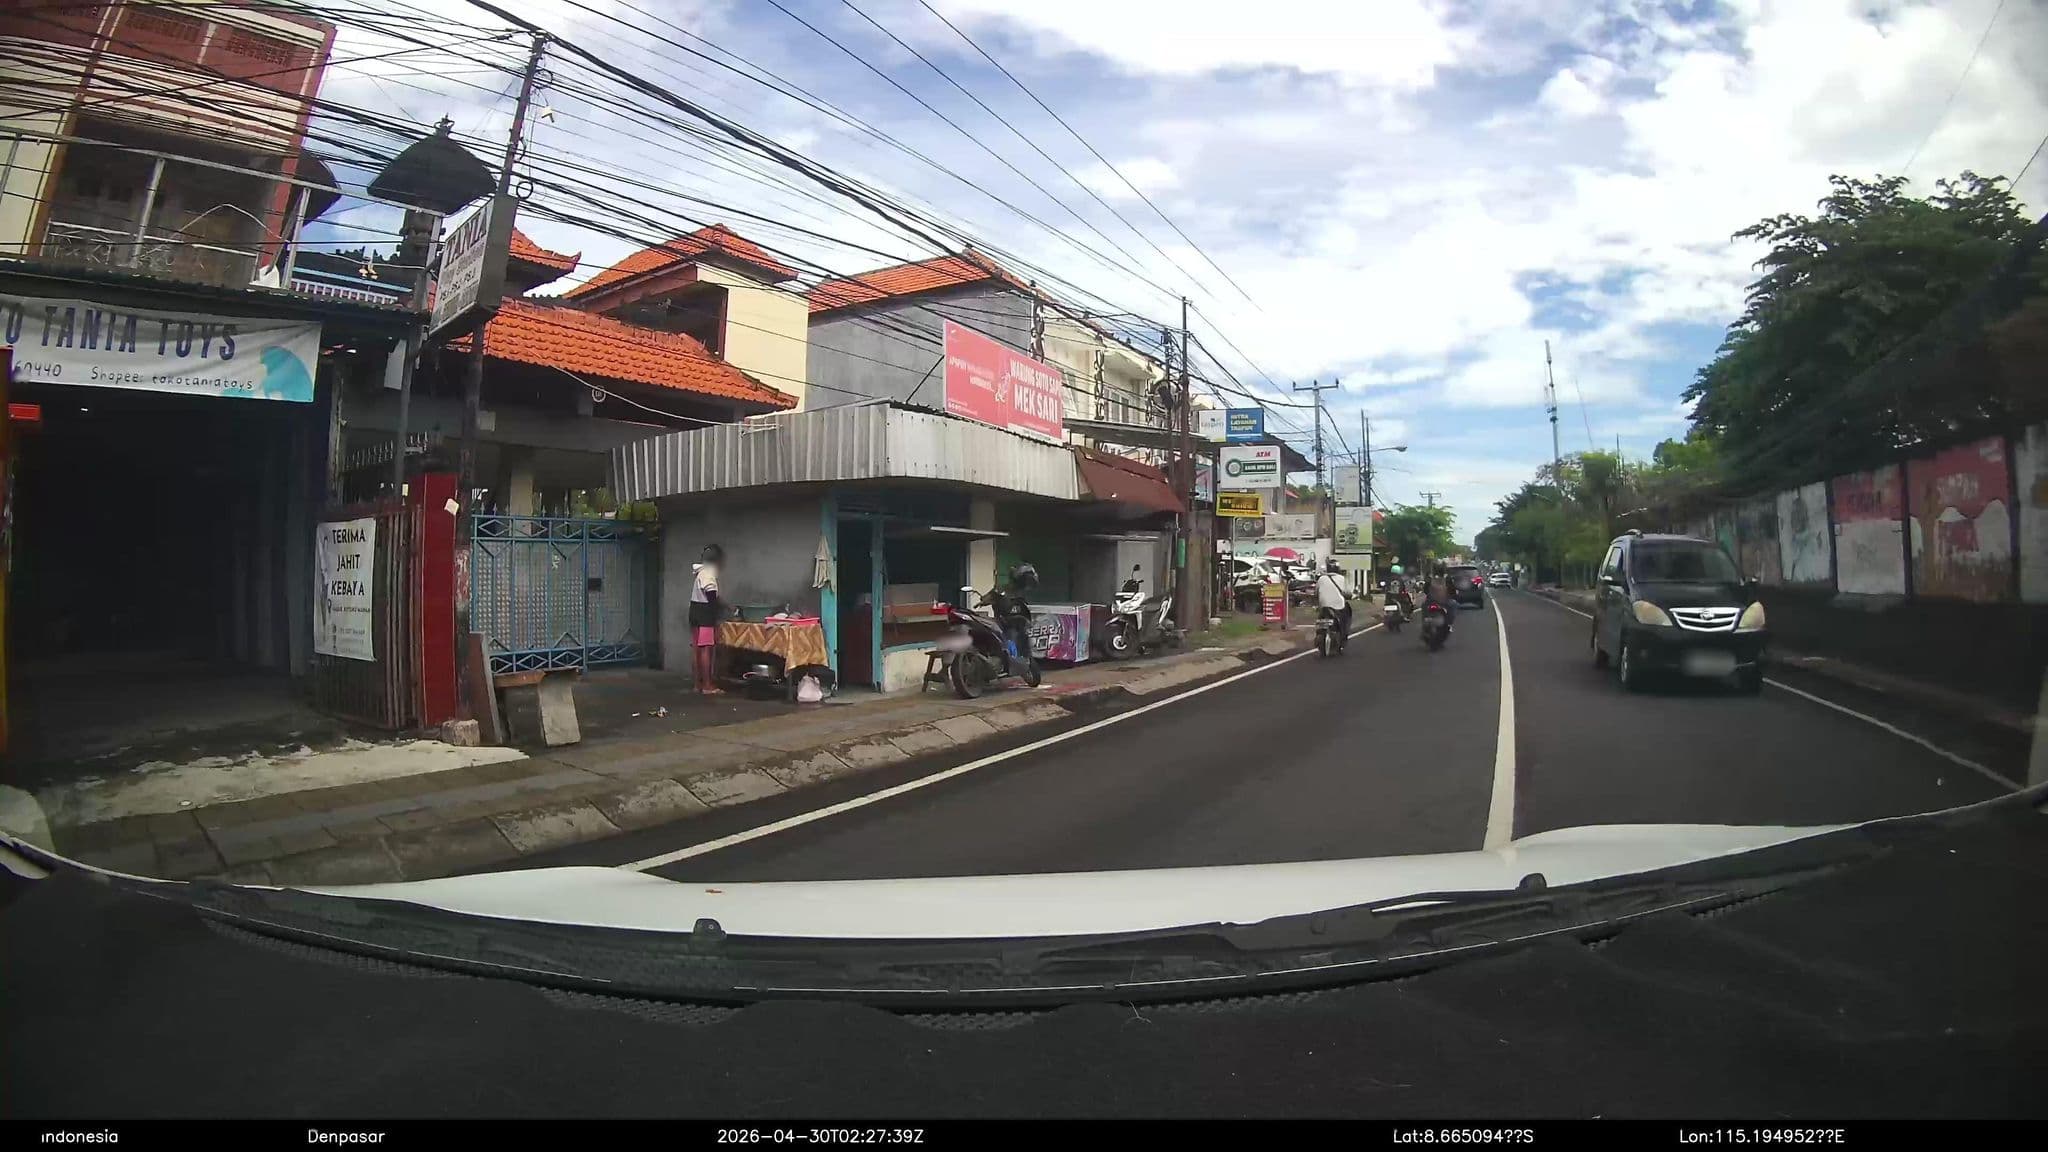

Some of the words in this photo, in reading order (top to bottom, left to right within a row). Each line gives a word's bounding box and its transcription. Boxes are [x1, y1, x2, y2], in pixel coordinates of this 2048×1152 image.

[443, 206, 488, 269] TANIA
[0, 302, 24, 344] O
[41, 305, 137, 353] TANIA
[158, 318, 238, 361] TOYS
[1014, 382, 1036, 416] MEK
[1037, 393, 1059, 424] SARI
[331, 528, 366, 545] TERIMA
[337, 554, 361, 572] JAHIT
[330, 580, 365, 597] KEBAYA
